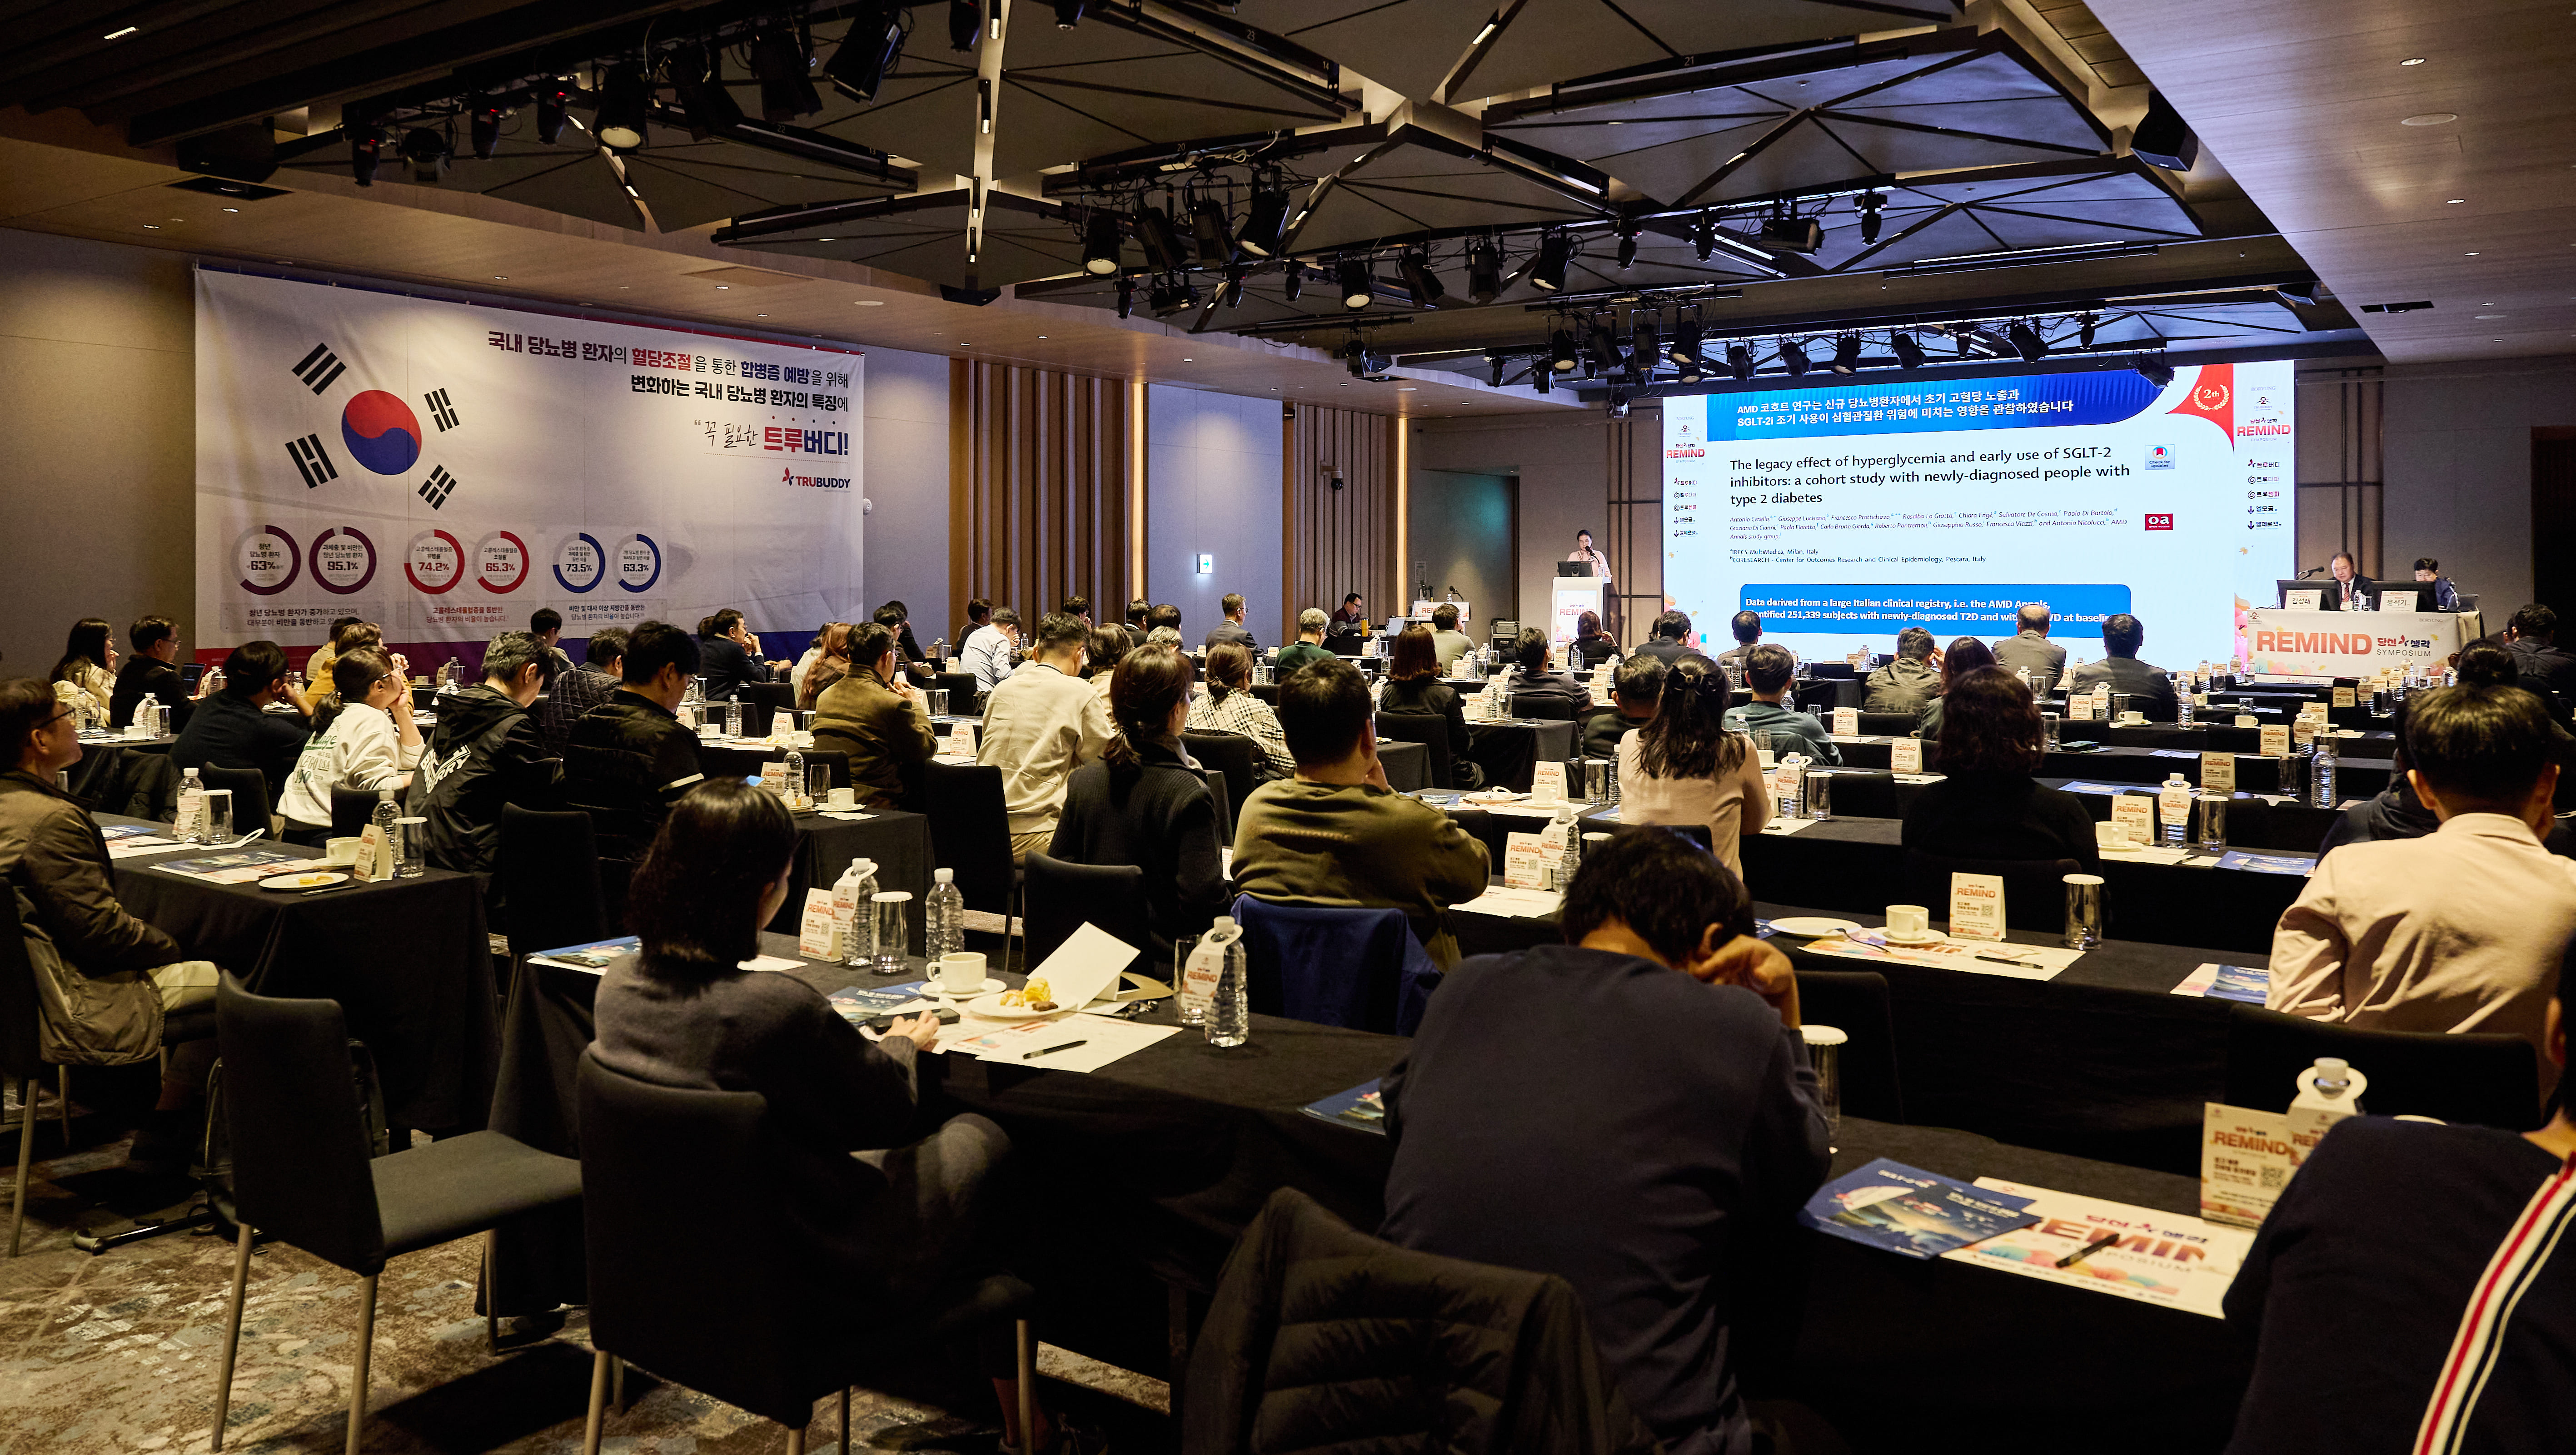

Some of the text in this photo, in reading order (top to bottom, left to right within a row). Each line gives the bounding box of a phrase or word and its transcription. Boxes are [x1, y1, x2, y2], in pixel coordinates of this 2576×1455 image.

[488, 331, 522, 353] 국내
[528, 336, 577, 358] 당뇨병
[582, 342, 626, 364] 환자의
[712, 358, 737, 376] 통한
[741, 361, 780, 381] 합병증
[784, 366, 822, 386] 예방을
[826, 372, 848, 388] 위해
[631, 374, 848, 412] 변화하는 국내 당뇨병 환자의 특징에
[2203, 389, 2219, 399] 2th
[1737, 389, 2019, 413] AMD 코호트 연구는 신규 당뇨병환자에서 초기 고혈당 노출과
[1738, 400, 2073, 426] SGLT-2i 조기 사용이 심혈관질환 위험에 미치는 영향을 관찰하였습니다
[2237, 424, 2291, 436] REMIND
[724, 423, 758, 448] 필요한
[764, 427, 848, 455] 트루버디!
[1666, 449, 1705, 458] REMIND
[1730, 447, 2112, 472] The legacy effect of hyperglycemia and early use of SGLT-2
[1730, 476, 1791, 487] inhibitors:
[1806, 474, 1846, 485] cohort
[1850, 472, 1885, 486] study
[1890, 472, 1919, 482] with
[1924, 467, 2039, 483] newly-diagnosed
[2044, 466, 2091, 482] people
[2096, 464, 2130, 476] with
[796, 476, 851, 488] TRUBUDDY
[1730, 493, 1822, 507] type 2 diabetes
[2148, 516, 2170, 525] oa
[327, 561, 358, 570] 95.1%
[419, 562, 449, 571] 74.2%
[485, 563, 515, 571] 65.3%
[566, 564, 592, 572] 73.5%
[623, 564, 649, 572] 63.3%
[1746, 598, 1765, 606] Data
[1767, 598, 1798, 607] derived
[1800, 598, 1821, 607] from
[1830, 598, 1851, 609] large
[1854, 599, 1881, 607] Italian
[1883, 599, 1913, 607] clinical
[1915, 599, 1952, 609] registry,
[1954, 600, 1968, 608] i.e.
[1970, 600, 1986, 608] the
[1988, 600, 2013, 609] AMD
[1787, 611, 1821, 619] 251,339
[1822, 611, 1858, 621] subjects
[1859, 611, 1880, 620] with
[1882, 611, 1958, 622] newly-diagnosed
[1981, 613, 1998, 621] and
[2063, 613, 2074, 622] at
[2257, 631, 2372, 655] REMIND
[2377, 637, 2431, 648] 당신 생각
[2377, 649, 2431, 657] SYMPOSIUM
[1510, 844, 1540, 854] REMIND
[1957, 887, 1996, 899] REMIND
[807, 904, 834, 916] REMIND
[2213, 1130, 2287, 1155] REMIND
